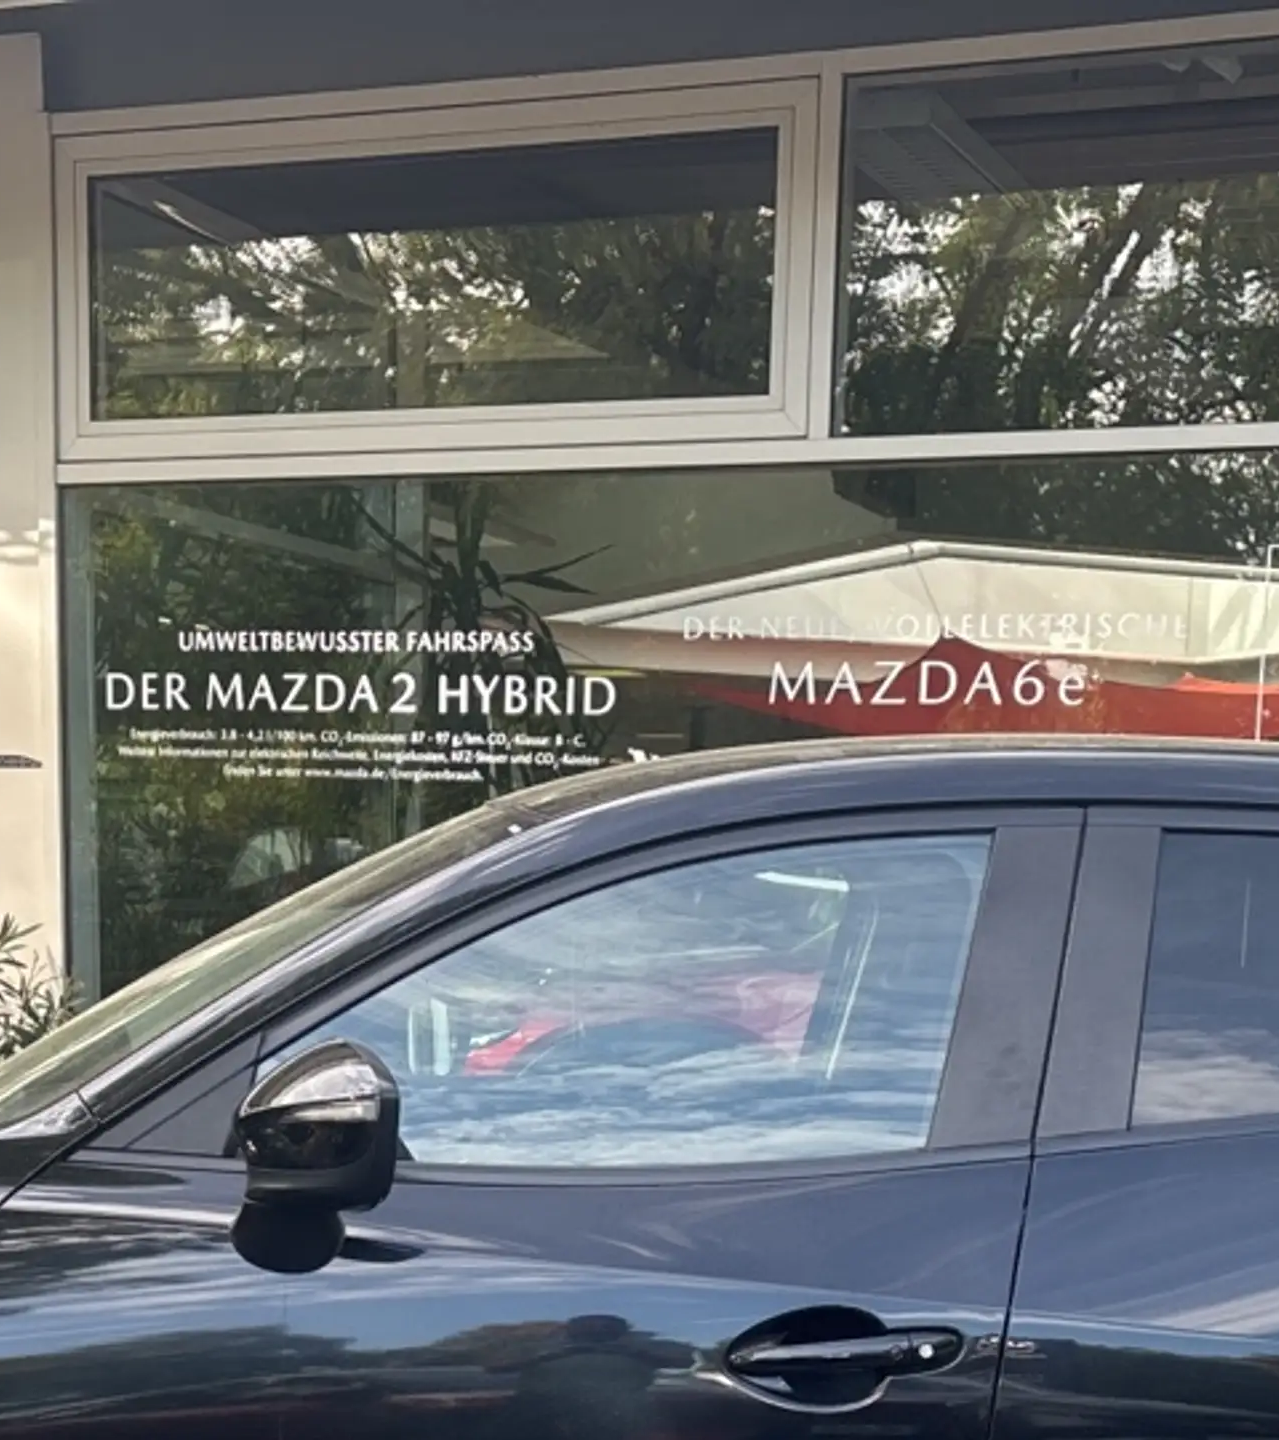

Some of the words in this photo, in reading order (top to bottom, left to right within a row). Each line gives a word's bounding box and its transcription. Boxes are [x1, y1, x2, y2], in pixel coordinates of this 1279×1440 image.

[178, 630, 400, 652] UMWELTBEWUSSTER
[406, 630, 535, 653] FAHRSPASS
[683, 616, 744, 640] DER
[104, 671, 191, 711] DER
[437, 674, 617, 716] HYBRID
[768, 659, 1087, 706] MAZDA6e
